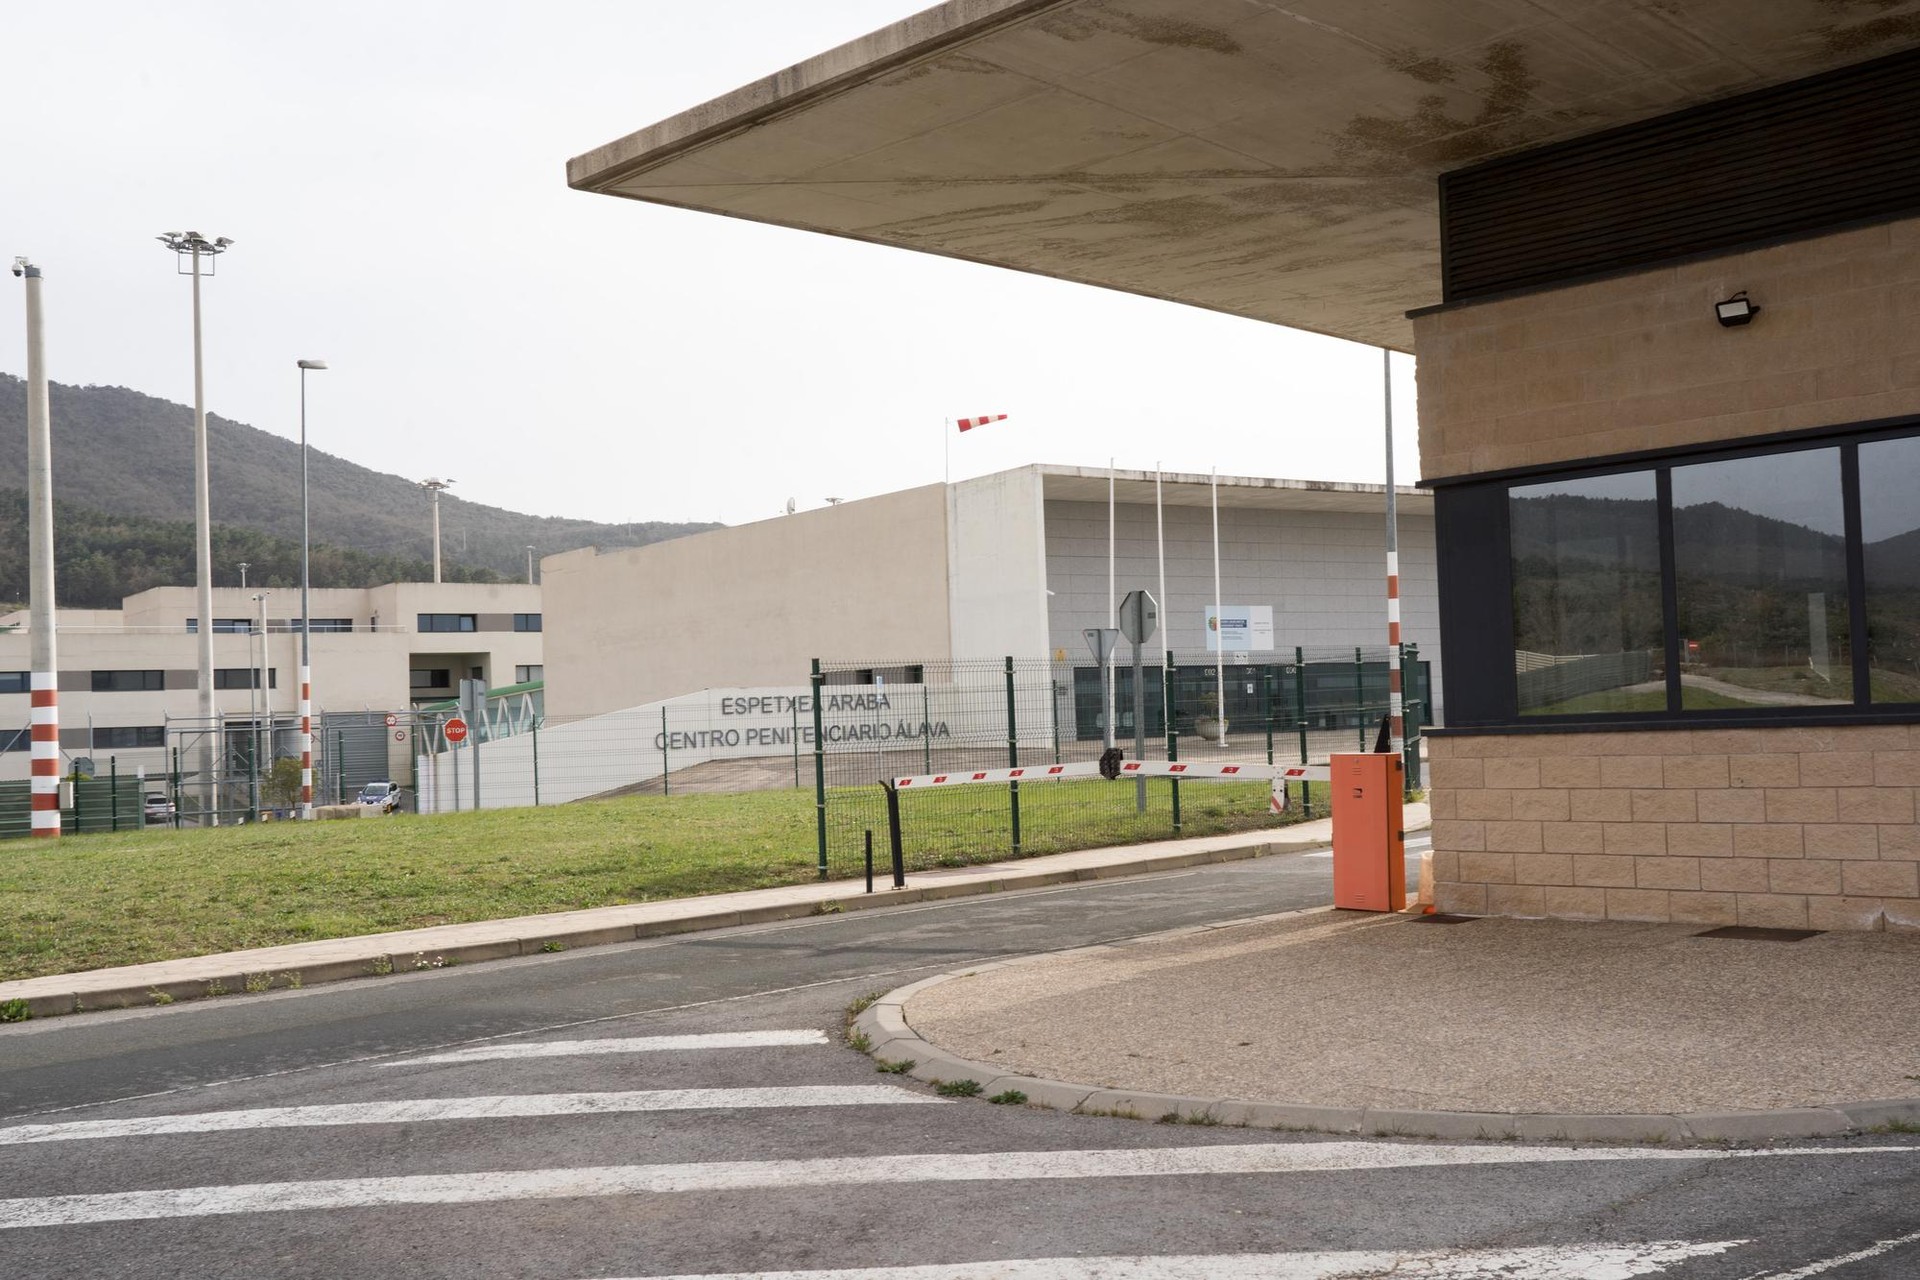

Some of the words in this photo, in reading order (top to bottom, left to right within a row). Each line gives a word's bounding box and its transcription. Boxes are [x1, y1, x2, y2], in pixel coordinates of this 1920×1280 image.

[828, 692, 891, 711] ARABA
[655, 729, 740, 750] CENTRO
[746, 723, 891, 746] PENITENCIARIO
[895, 718, 950, 739] ÁLAVA
